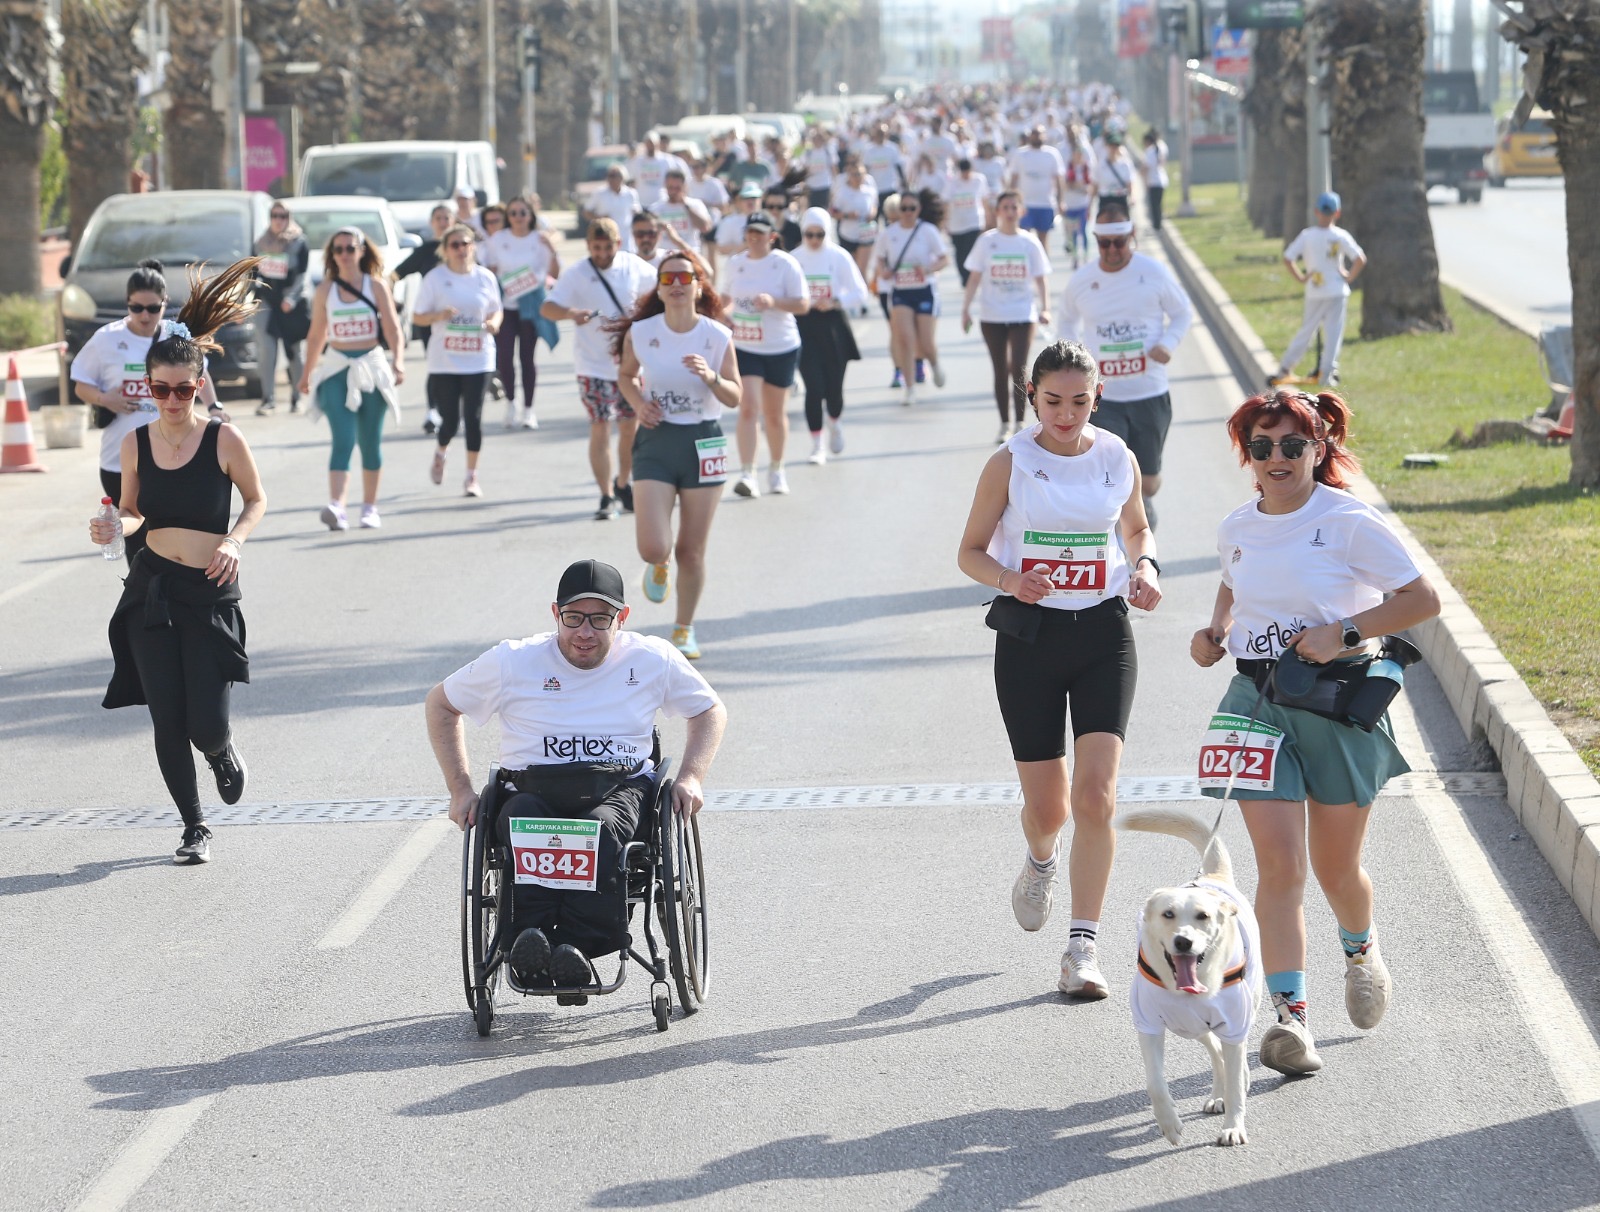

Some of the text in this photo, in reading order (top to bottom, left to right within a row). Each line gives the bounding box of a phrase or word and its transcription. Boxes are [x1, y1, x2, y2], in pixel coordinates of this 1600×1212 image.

[1103, 361, 1142, 375] 0120
[125, 382, 151, 397] 02
[1039, 536, 1073, 544] KARŞIYAKA
[543, 735, 637, 762] Reflex PLUS
[1202, 749, 1265, 775] 0262
[525, 823, 561, 831] KARŞIYAKA
[562, 824, 596, 832] BELEDİYESİ
[520, 851, 589, 876] 0842
